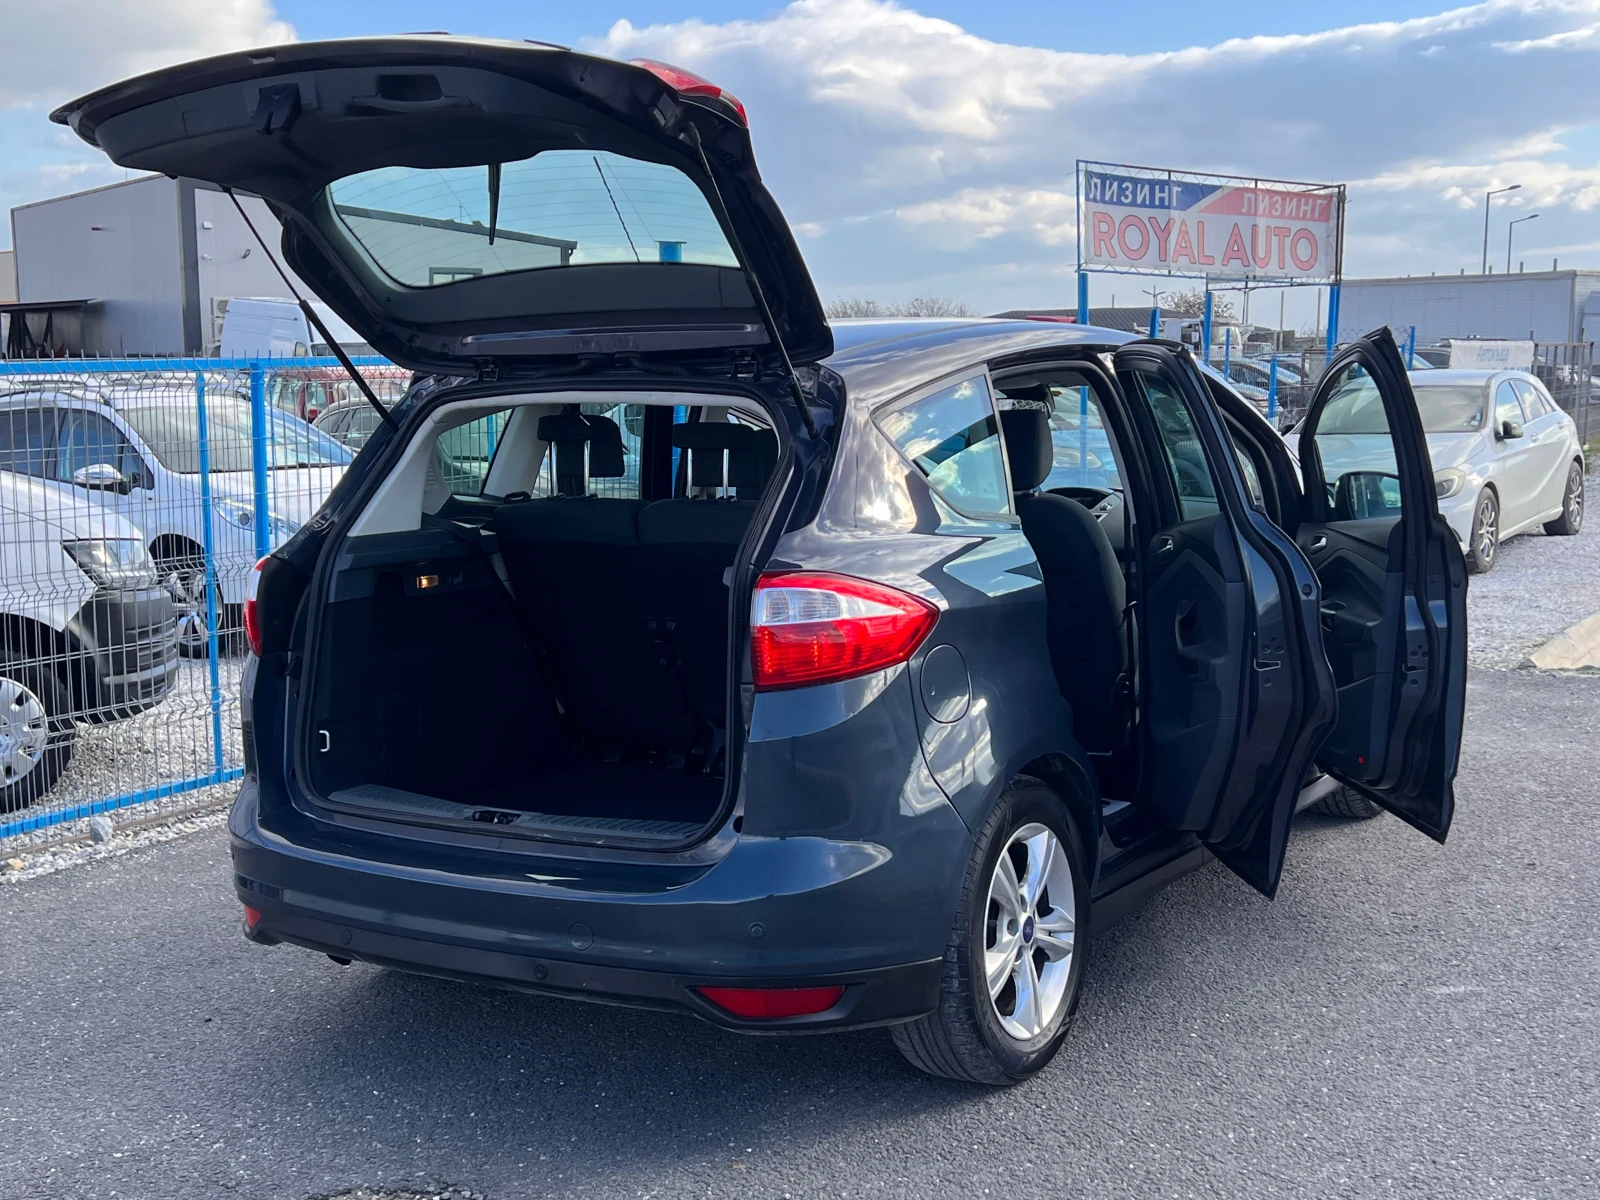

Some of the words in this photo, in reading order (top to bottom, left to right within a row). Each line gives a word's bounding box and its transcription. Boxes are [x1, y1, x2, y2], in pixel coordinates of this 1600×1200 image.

[1089, 177, 1182, 207] ЛИЗИНГ
[1241, 192, 1327, 219] ЛИЗИНГ
[1092, 211, 1216, 266] ROYAL
[1221, 222, 1319, 271] AUTO
